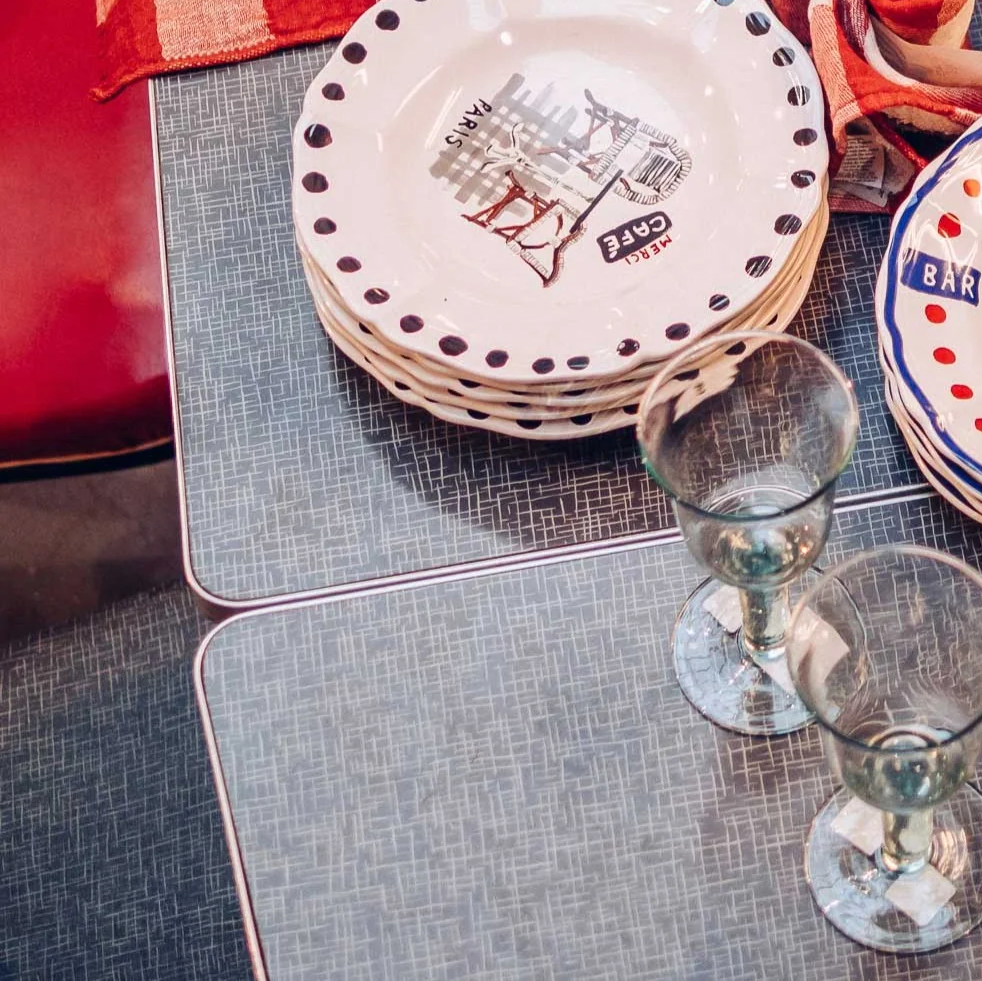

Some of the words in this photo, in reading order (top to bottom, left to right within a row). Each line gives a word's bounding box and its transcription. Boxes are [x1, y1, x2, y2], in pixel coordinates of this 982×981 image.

[445, 98, 492, 149] PARIS
[603, 215, 667, 258] CAFÉ
[625, 234, 672, 265] MERCI
[923, 263, 975, 299] BAR
